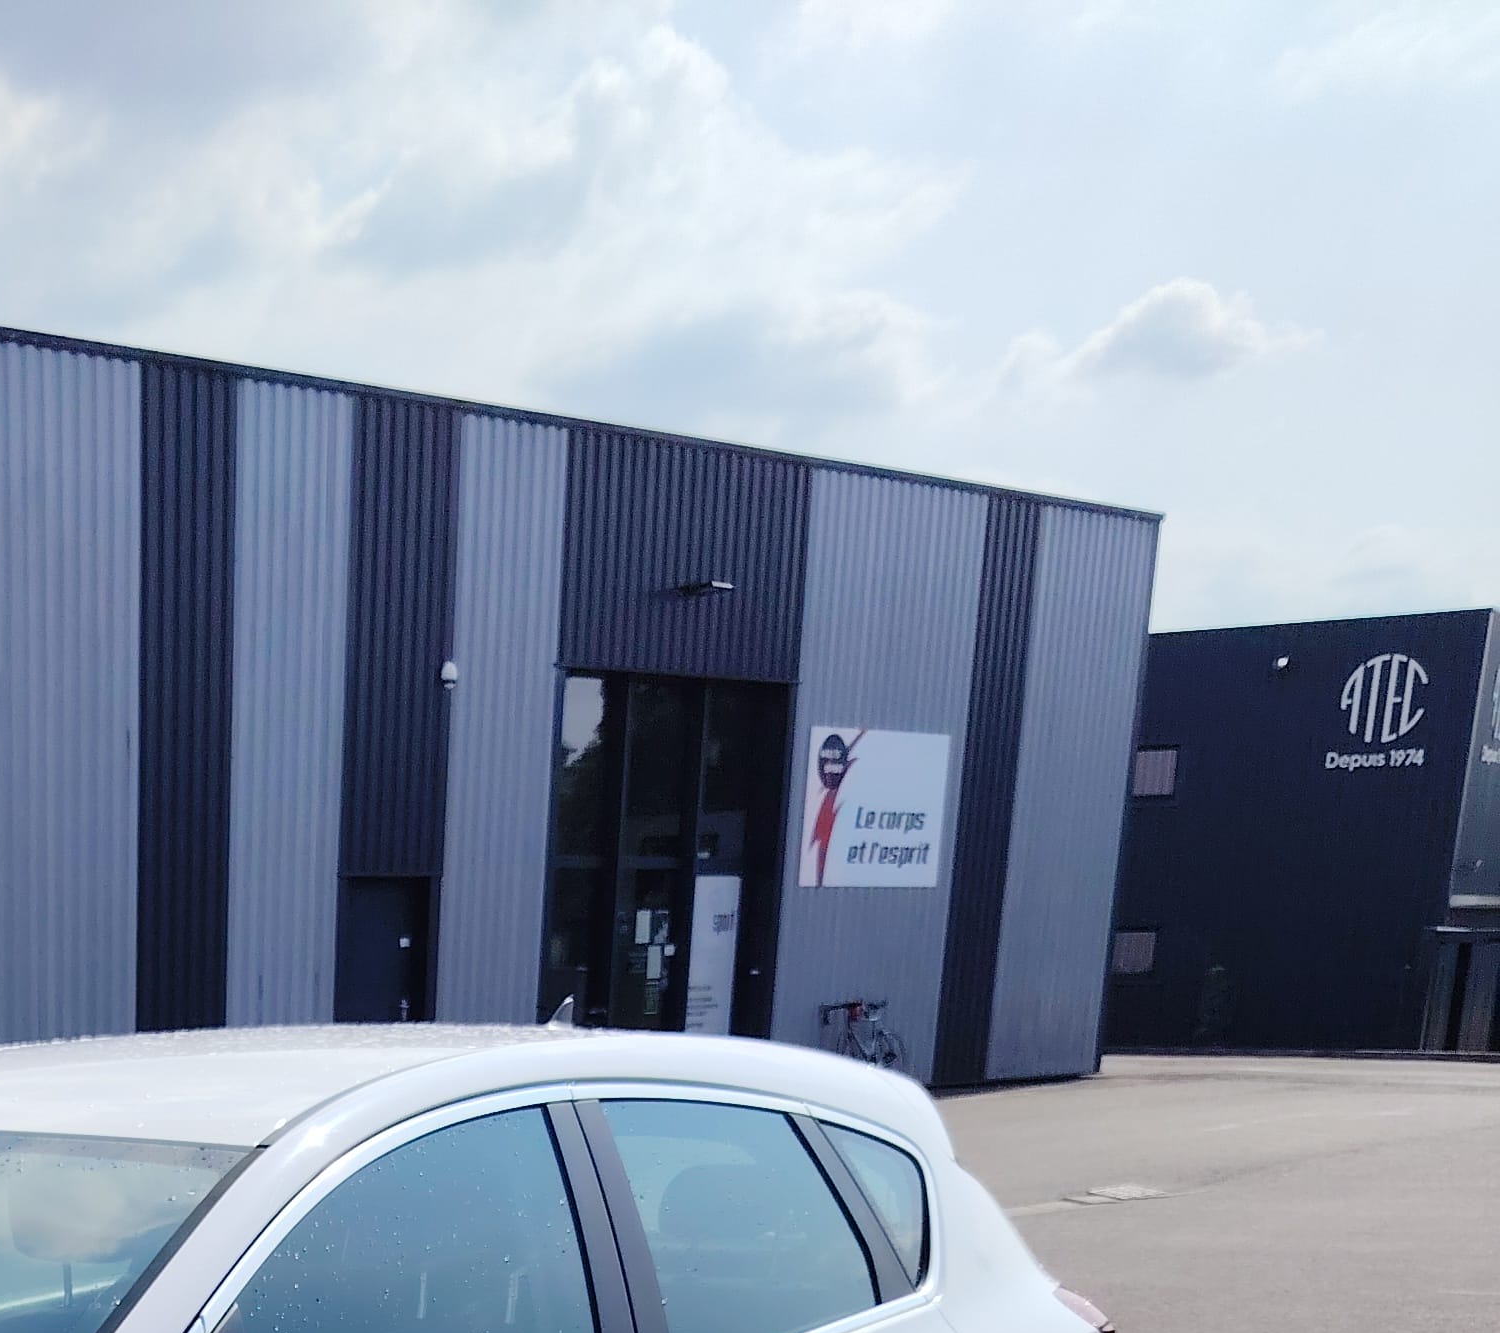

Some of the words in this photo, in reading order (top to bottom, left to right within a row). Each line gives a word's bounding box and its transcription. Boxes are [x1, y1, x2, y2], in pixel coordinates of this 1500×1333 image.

[1340, 653, 1429, 743] ATEC
[1324, 751, 1386, 772] Depuis
[1389, 748, 1425, 767] 1974
[856, 806, 876, 829] Le
[878, 810, 926, 834] corps
[846, 840, 867, 865] et
[867, 842, 930, 868] l'esprit
